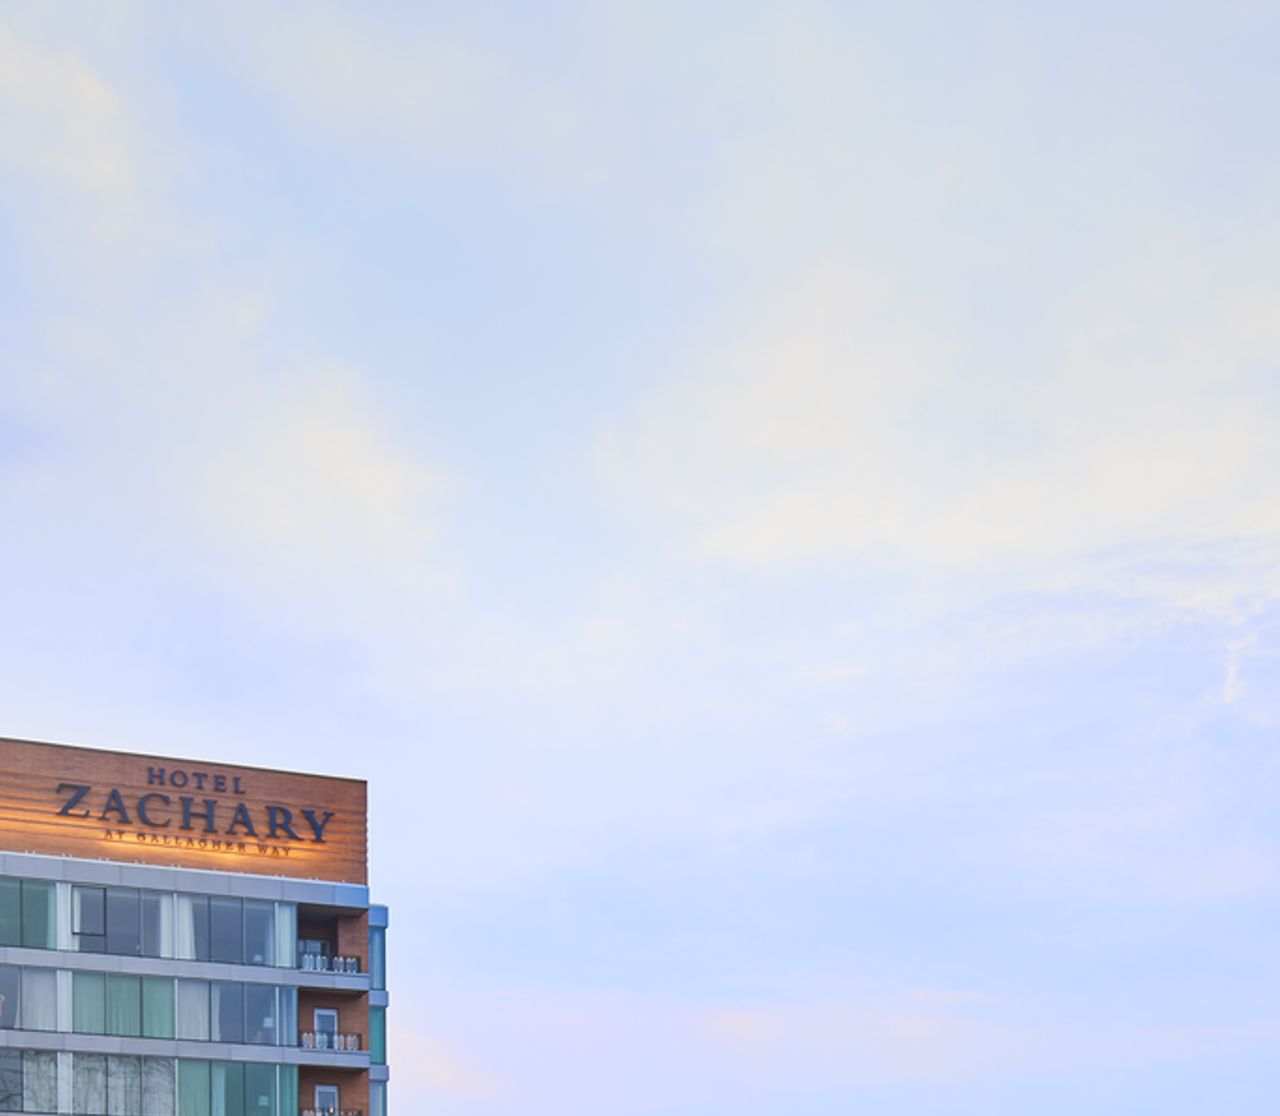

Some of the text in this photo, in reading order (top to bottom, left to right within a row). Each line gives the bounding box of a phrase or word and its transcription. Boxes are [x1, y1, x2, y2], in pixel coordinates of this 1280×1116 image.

[147, 766, 246, 795] HOTEL
[55, 782, 335, 844] ZACHARY
[136, 832, 247, 853] GALLAGHER
[257, 843, 291, 857] WAY
